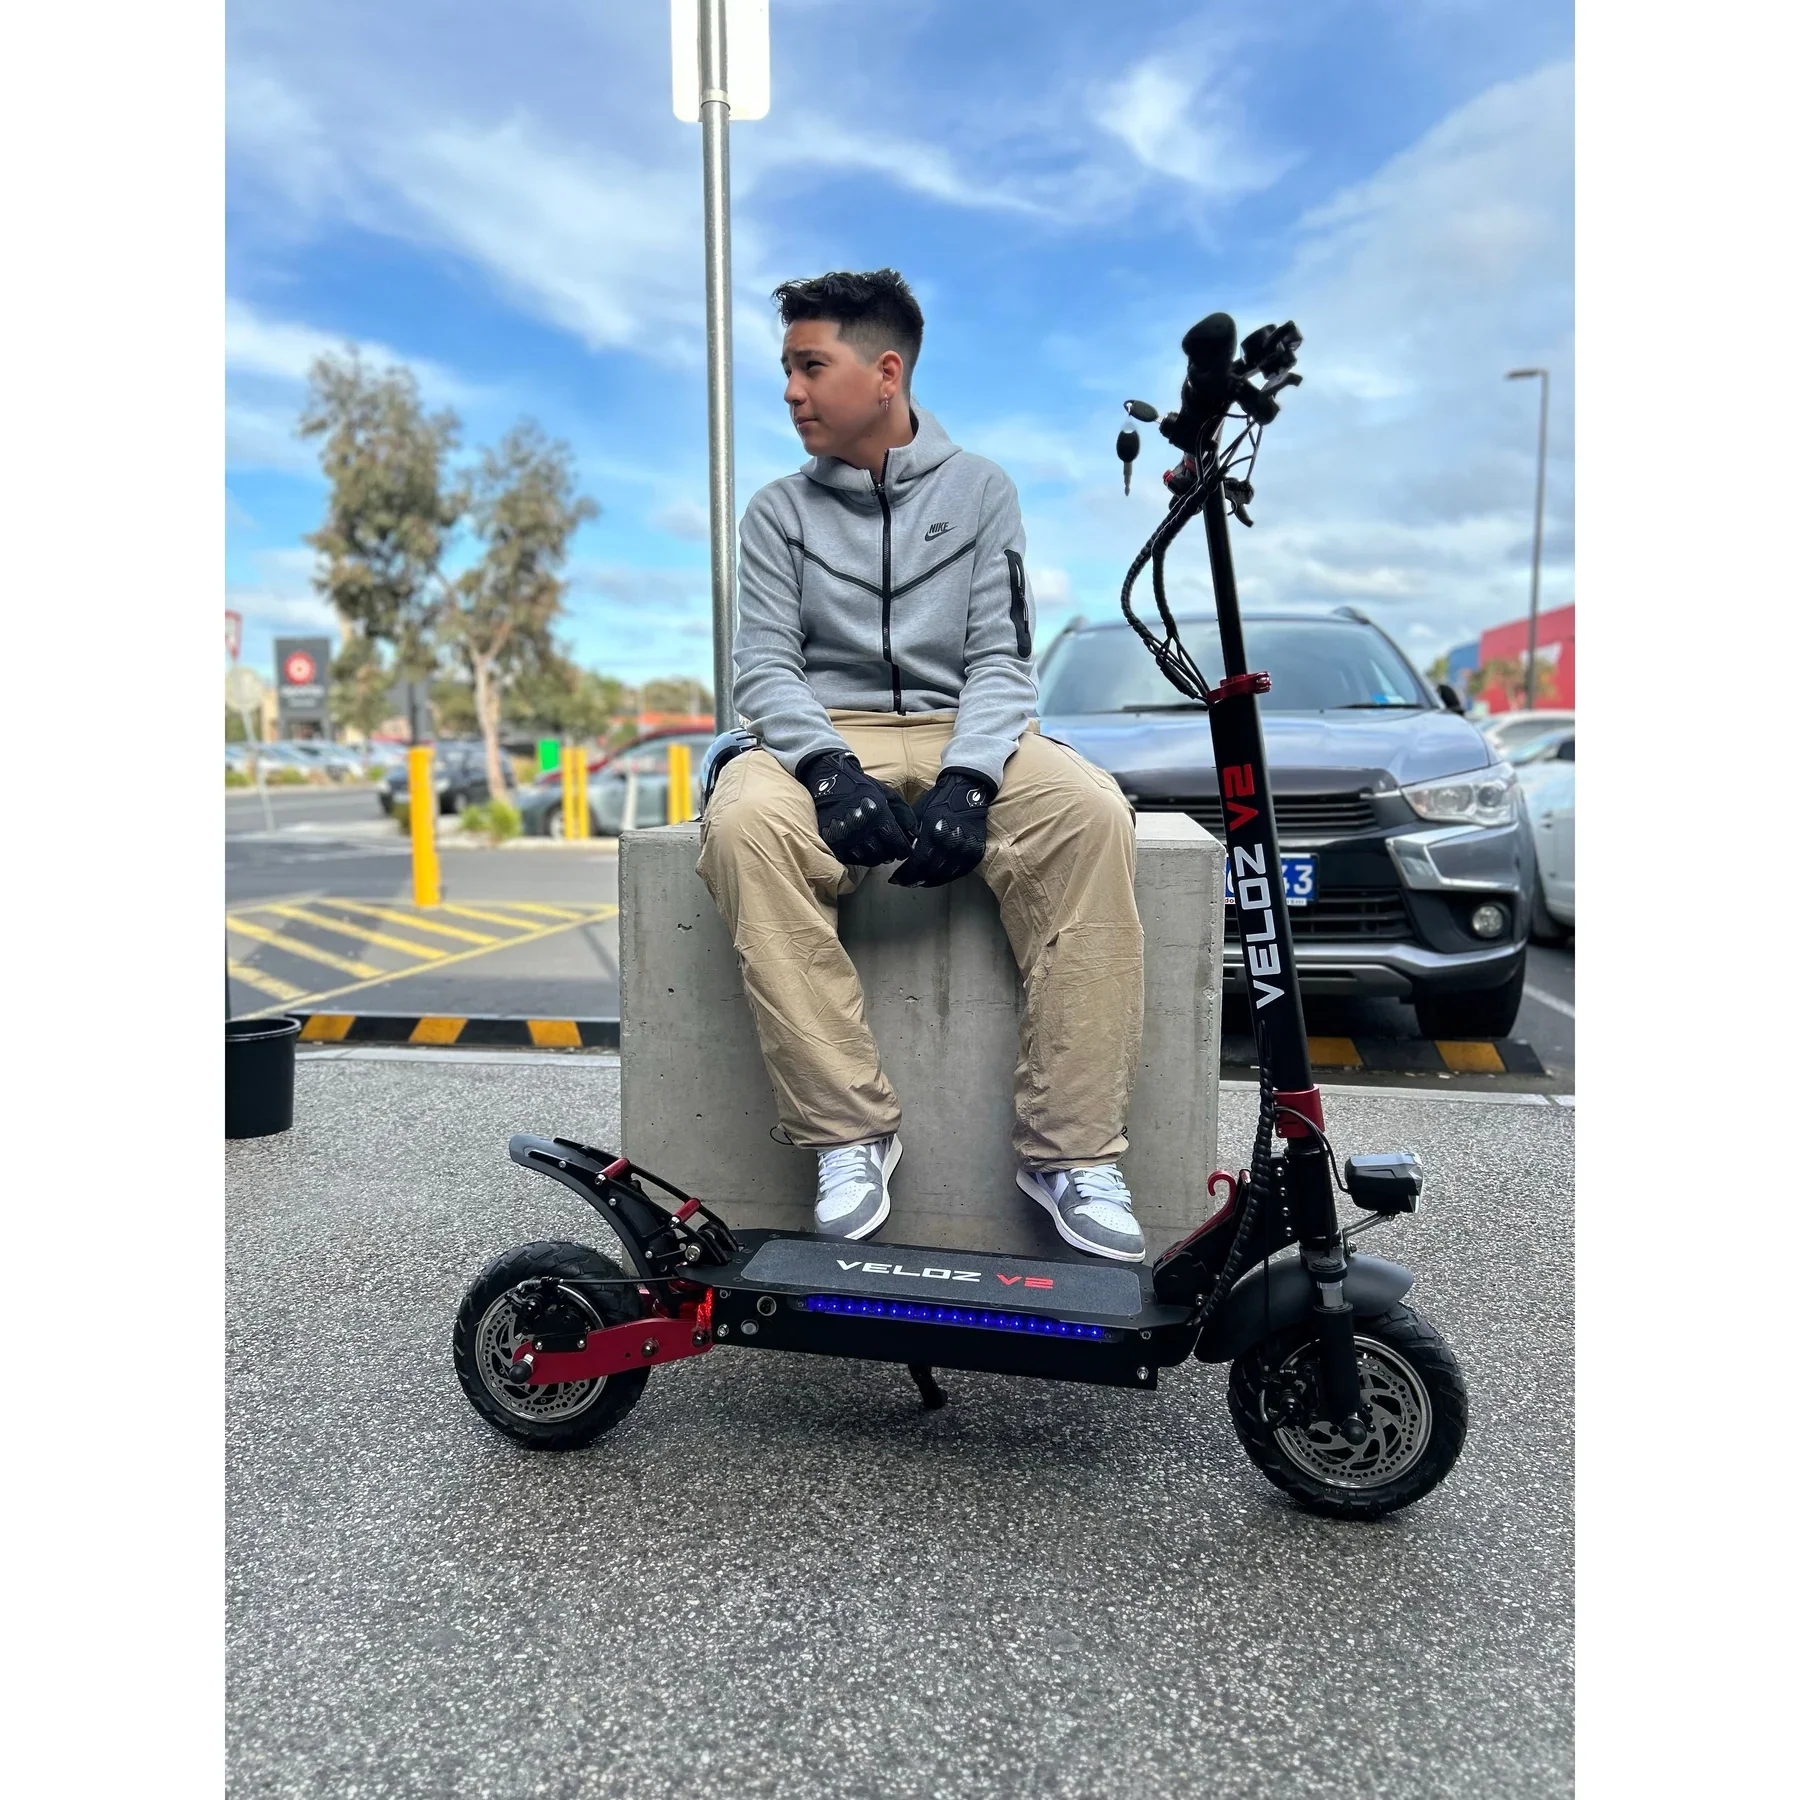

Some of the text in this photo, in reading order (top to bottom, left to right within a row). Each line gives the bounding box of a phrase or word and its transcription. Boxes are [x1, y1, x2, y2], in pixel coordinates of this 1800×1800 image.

[929, 521, 949, 534] NIKE
[1222, 763, 1285, 1010] VELOZ V2
[836, 1259, 1054, 1289] VELOZ V2
